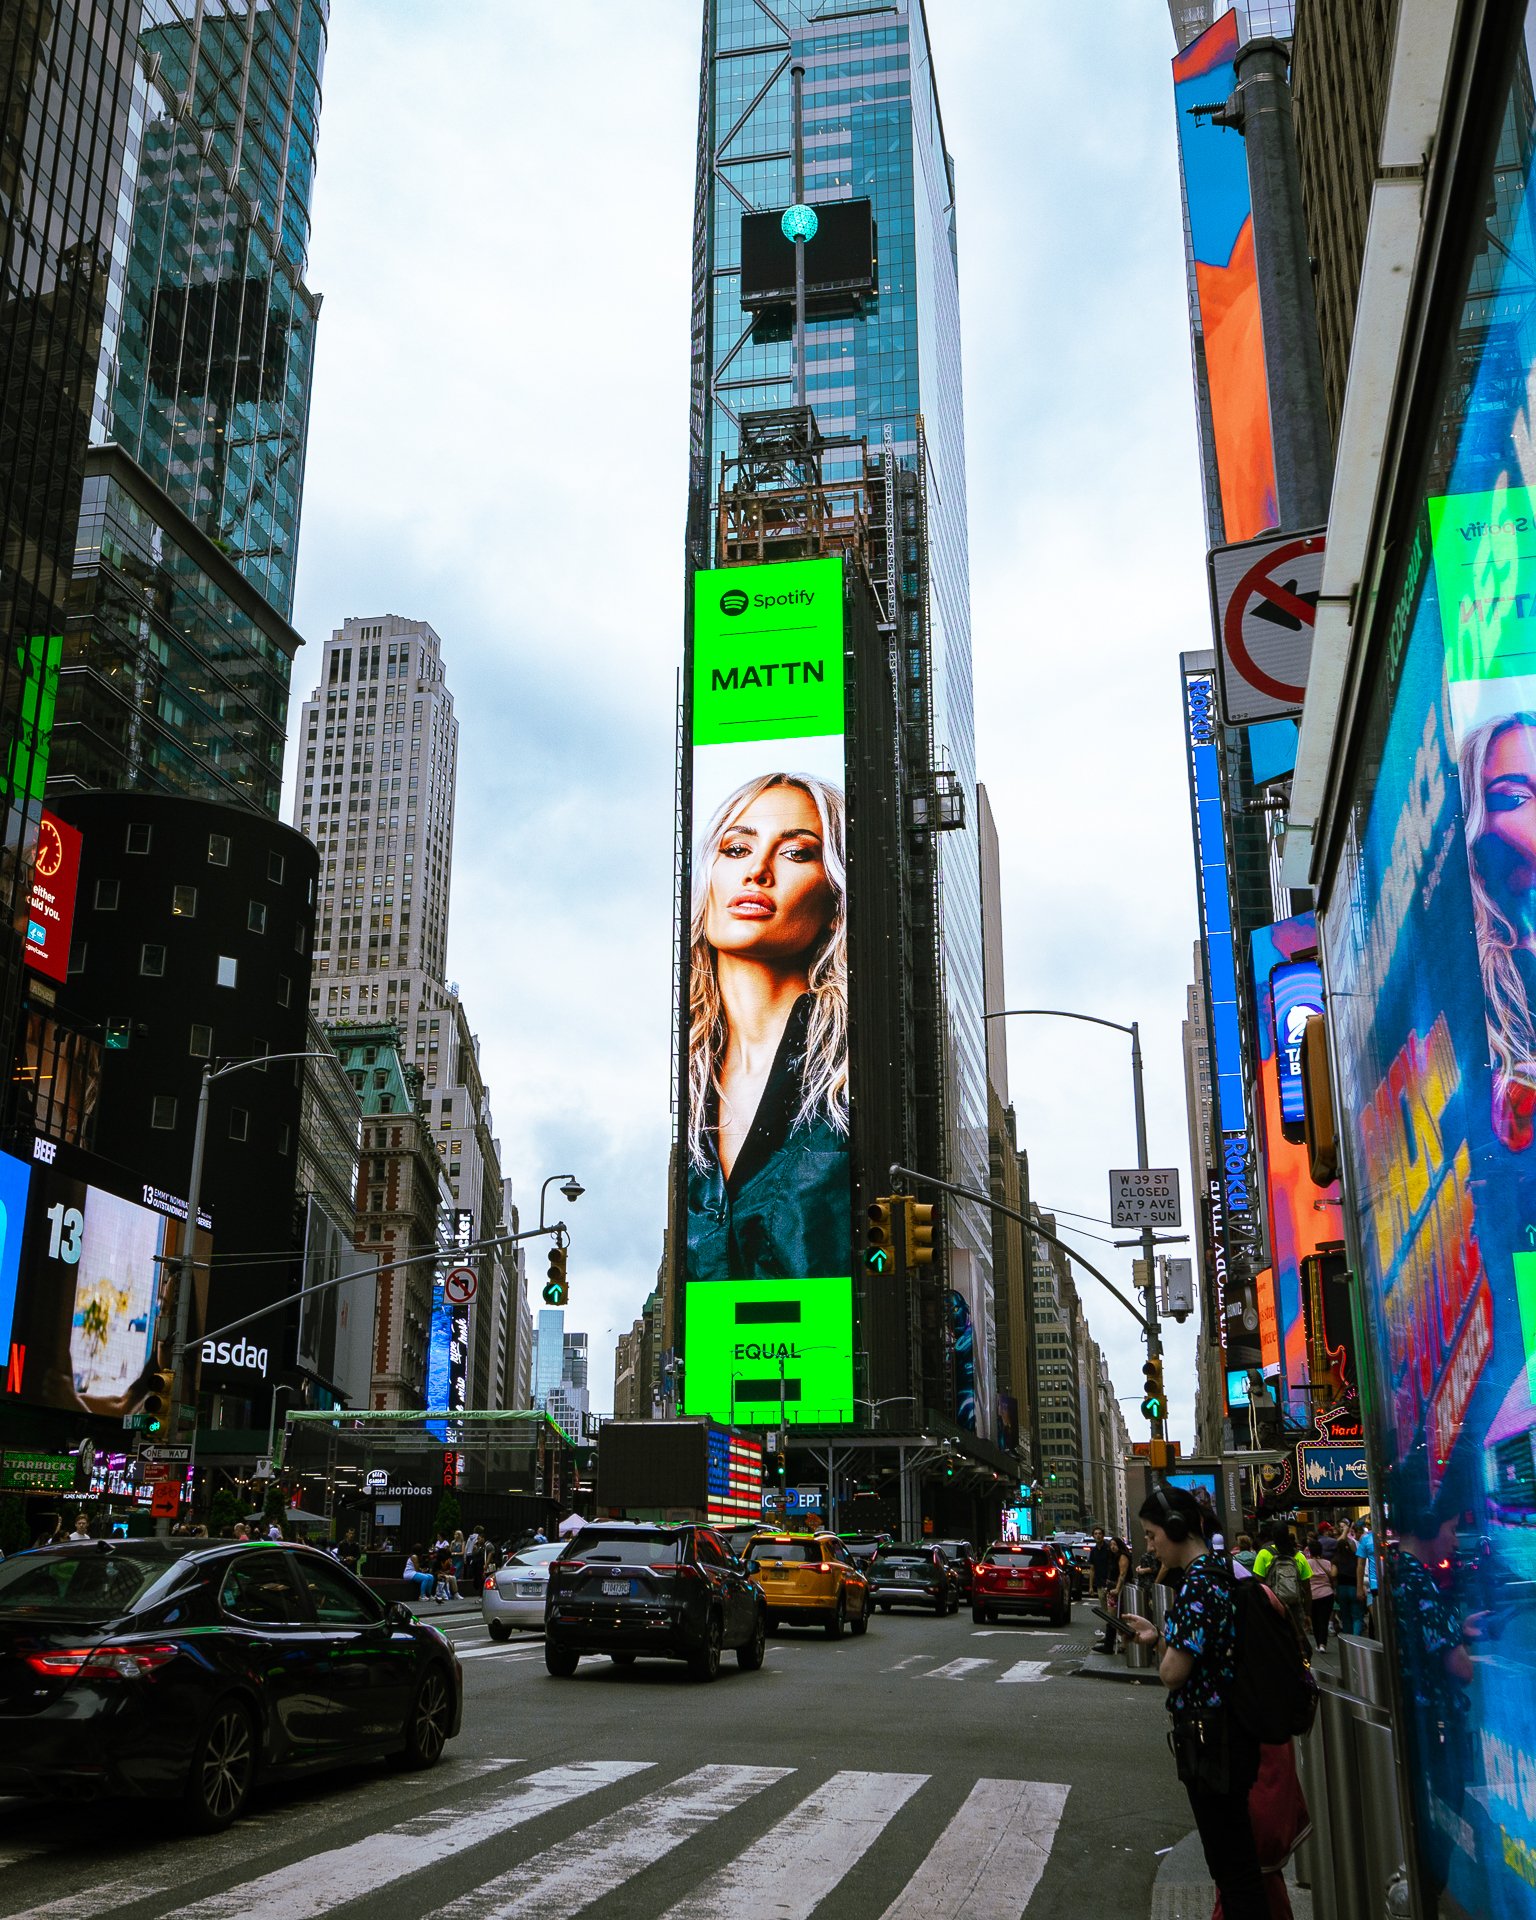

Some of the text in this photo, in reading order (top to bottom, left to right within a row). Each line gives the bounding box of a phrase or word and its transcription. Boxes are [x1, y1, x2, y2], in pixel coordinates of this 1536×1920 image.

[753, 589, 815, 610] Spotify
[711, 660, 824, 692] MATTN
[33, 885, 56, 905] either
[44, 904, 60, 921] you.
[33, 1136, 57, 1165] BEEF
[1120, 1175, 1168, 1185] W 39 ST
[142, 1184, 154, 1205] 13
[1121, 1187, 1170, 1197] CLOSED
[1117, 1199, 1175, 1209] AT 9 AVE
[47, 1202, 84, 1265] 13
[454, 1213, 471, 1267] Lcker.
[201, 1337, 268, 1378] asdaq
[735, 1342, 802, 1360] EQUAL
[1331, 1424, 1358, 1436] Hard
[3, 1460, 75, 1471] STARBUCKS
[444, 1453, 453, 1486] BAR
[13, 1471, 59, 1482] COFFEE
[388, 1487, 433, 1496] HOTDOGS
[1228, 1472, 1237, 1512] Newsstand
